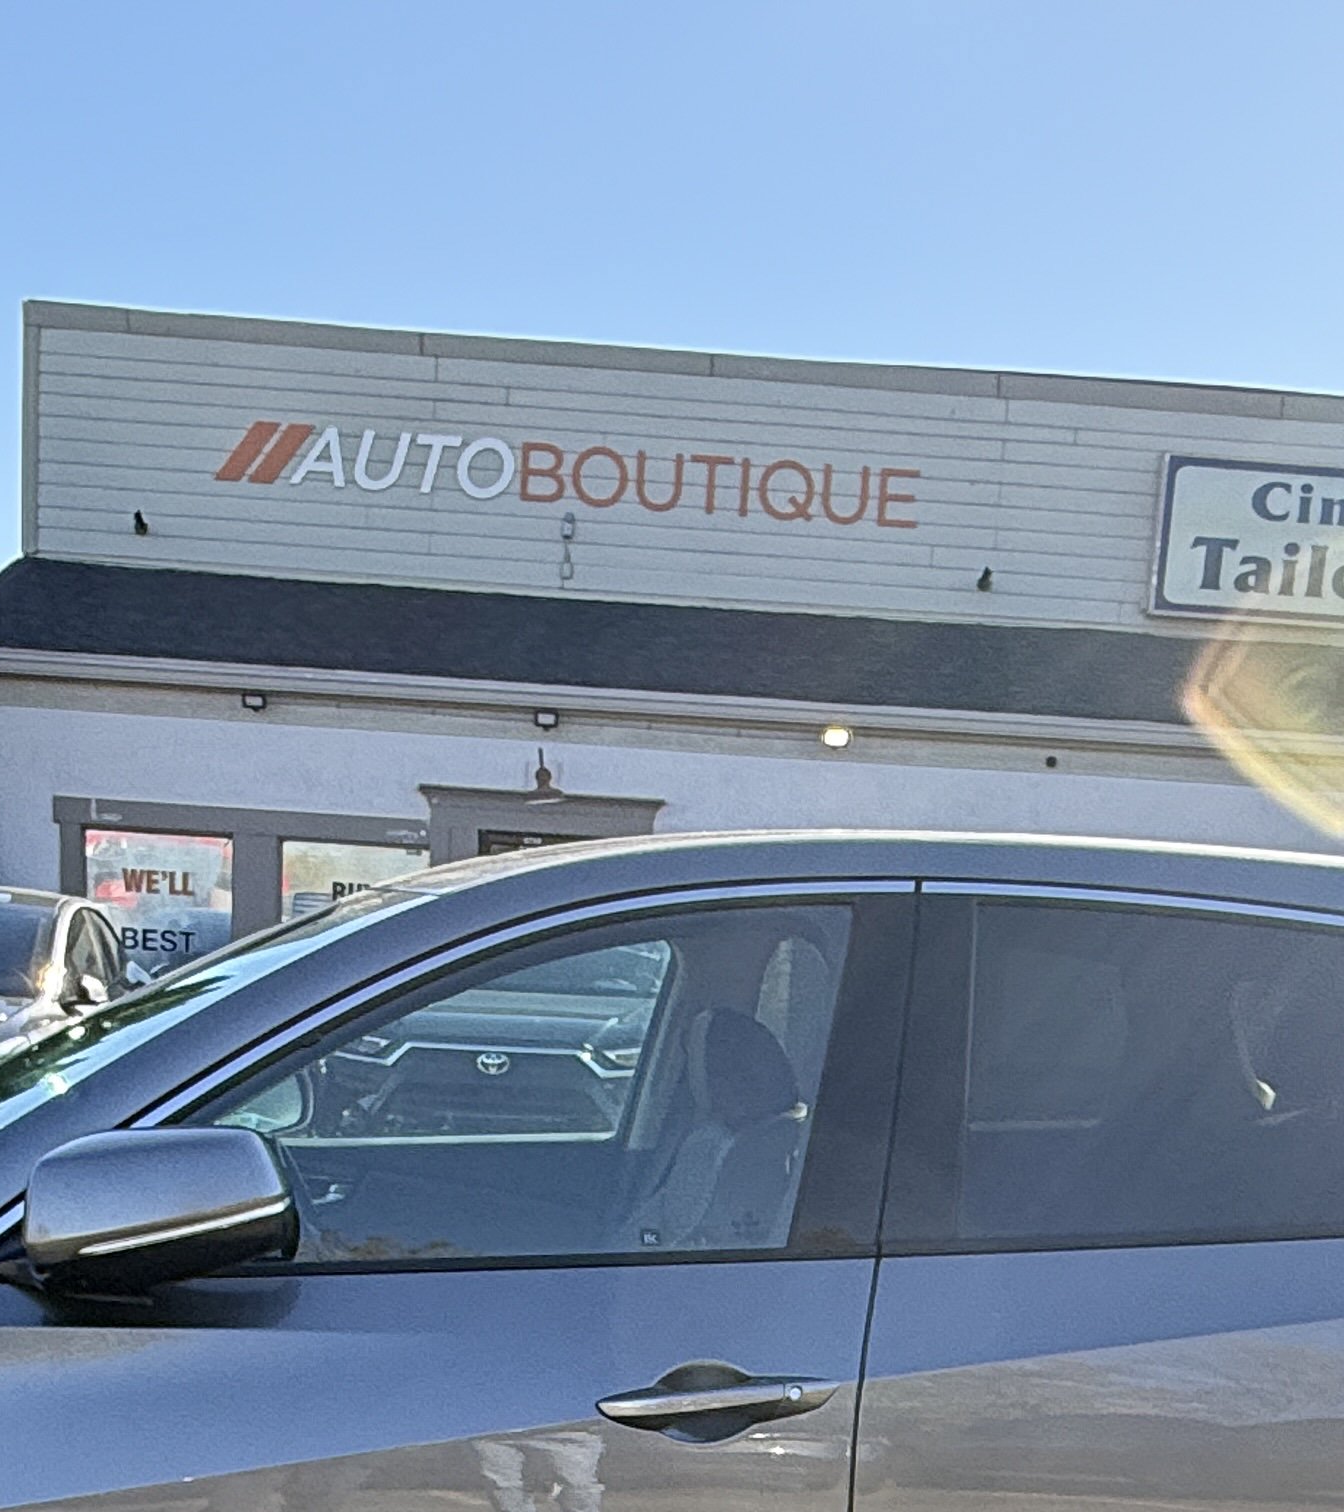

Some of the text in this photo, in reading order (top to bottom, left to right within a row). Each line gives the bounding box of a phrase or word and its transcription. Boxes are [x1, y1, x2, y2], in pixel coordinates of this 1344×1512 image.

[289, 425, 921, 529] AUTOBOUTIQUE
[121, 867, 195, 896] WE'LL
[120, 926, 196, 953] BEST
